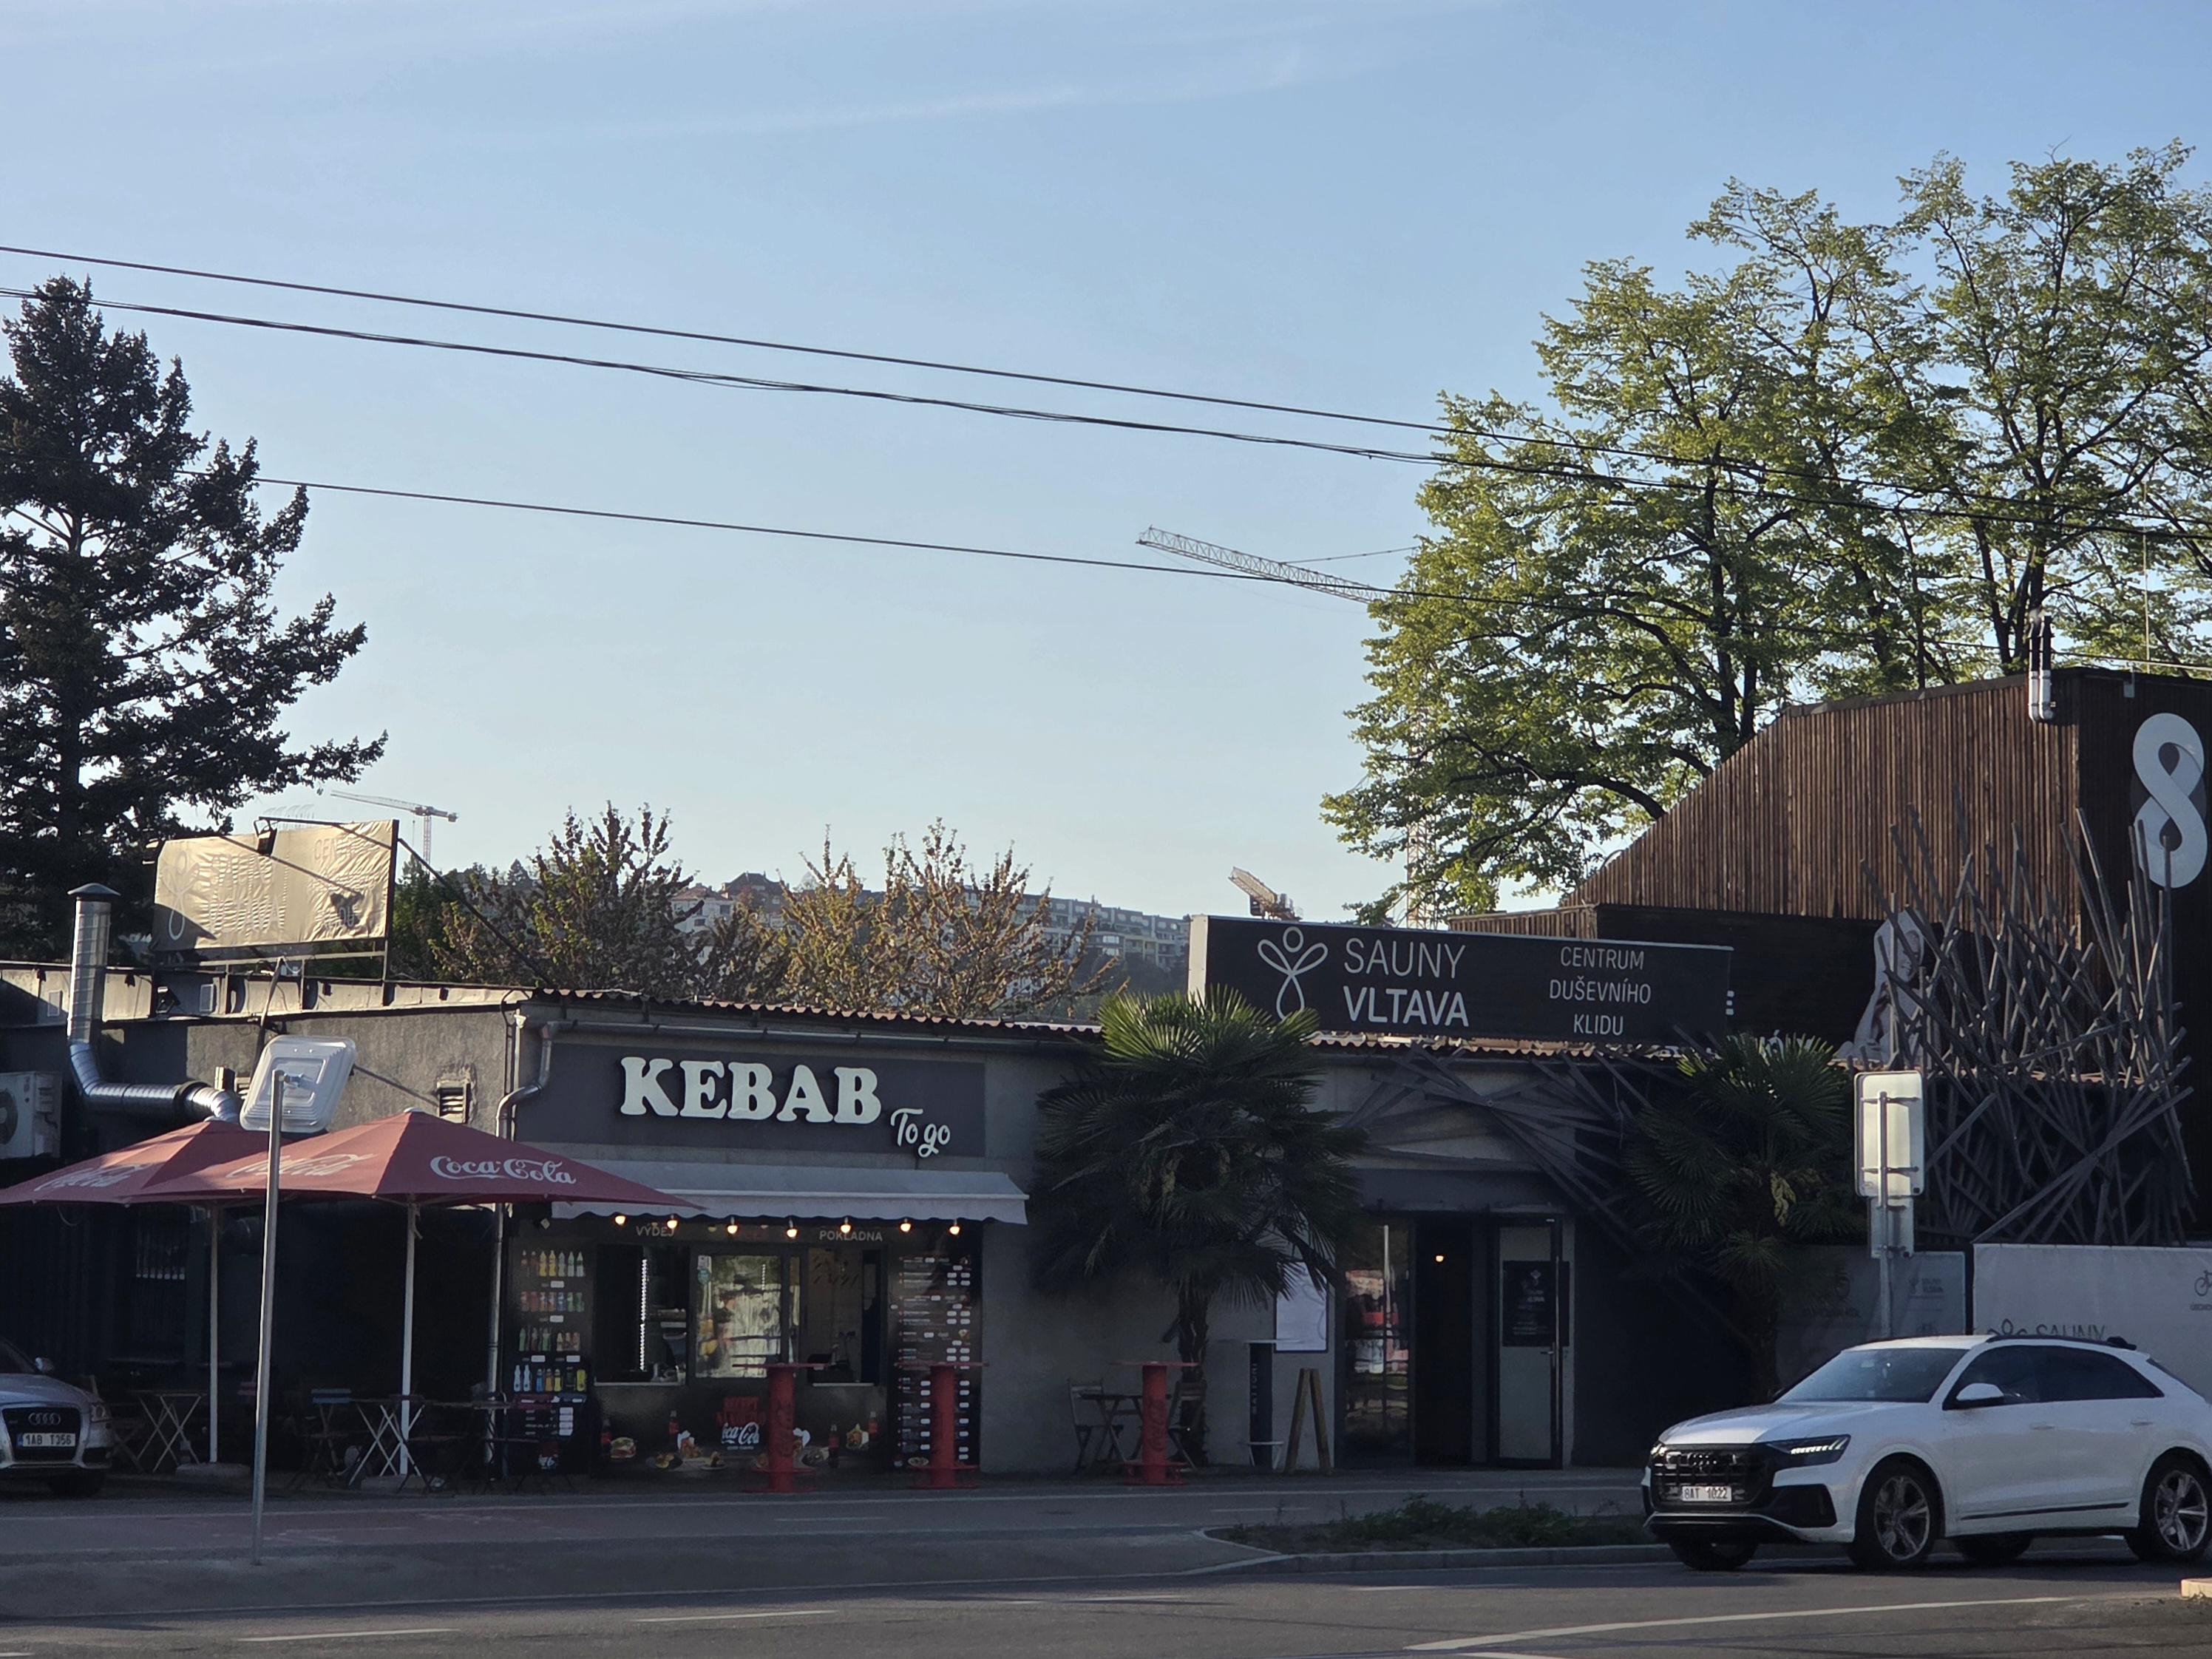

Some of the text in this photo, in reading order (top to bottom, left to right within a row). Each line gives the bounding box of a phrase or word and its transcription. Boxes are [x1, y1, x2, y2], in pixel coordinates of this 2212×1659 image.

[1344, 937, 1466, 978] SAUNY
[1560, 946, 1645, 970] CENTRUM
[1343, 985, 1470, 1027] VLTAVA
[1550, 975, 1652, 1004] DUŠEVNÍHO
[1573, 1014, 1624, 1035] KLIDU
[620, 1056, 882, 1124] KEBAB
[890, 1108, 951, 1158] To go
[819, 1229, 883, 1243] POKLADNA
